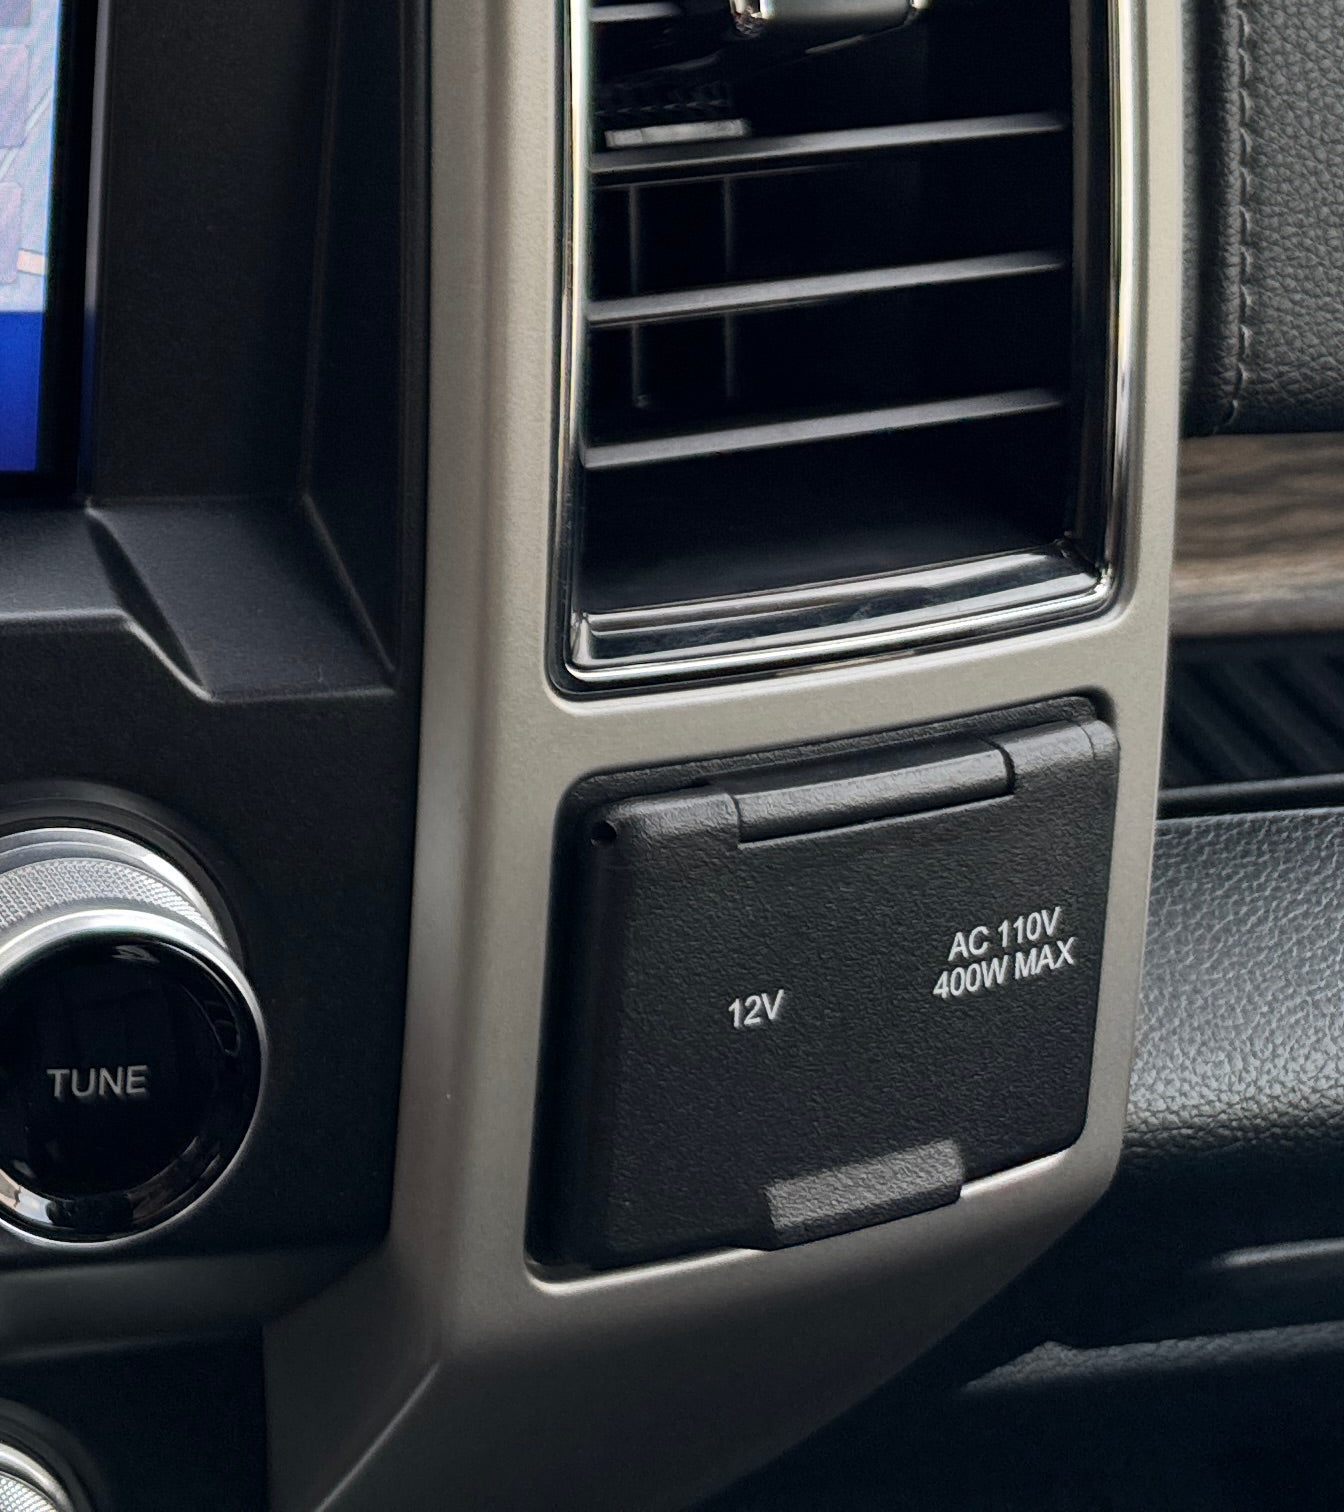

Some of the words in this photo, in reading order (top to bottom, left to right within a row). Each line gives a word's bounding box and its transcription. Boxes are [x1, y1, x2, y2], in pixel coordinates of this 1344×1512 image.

[948, 926, 989, 961] AC
[997, 906, 1063, 947] 110V
[933, 960, 1009, 1000] 400W
[1014, 937, 1077, 980] MAX
[728, 989, 786, 1028] 12V
[47, 1065, 149, 1100] TUNE
